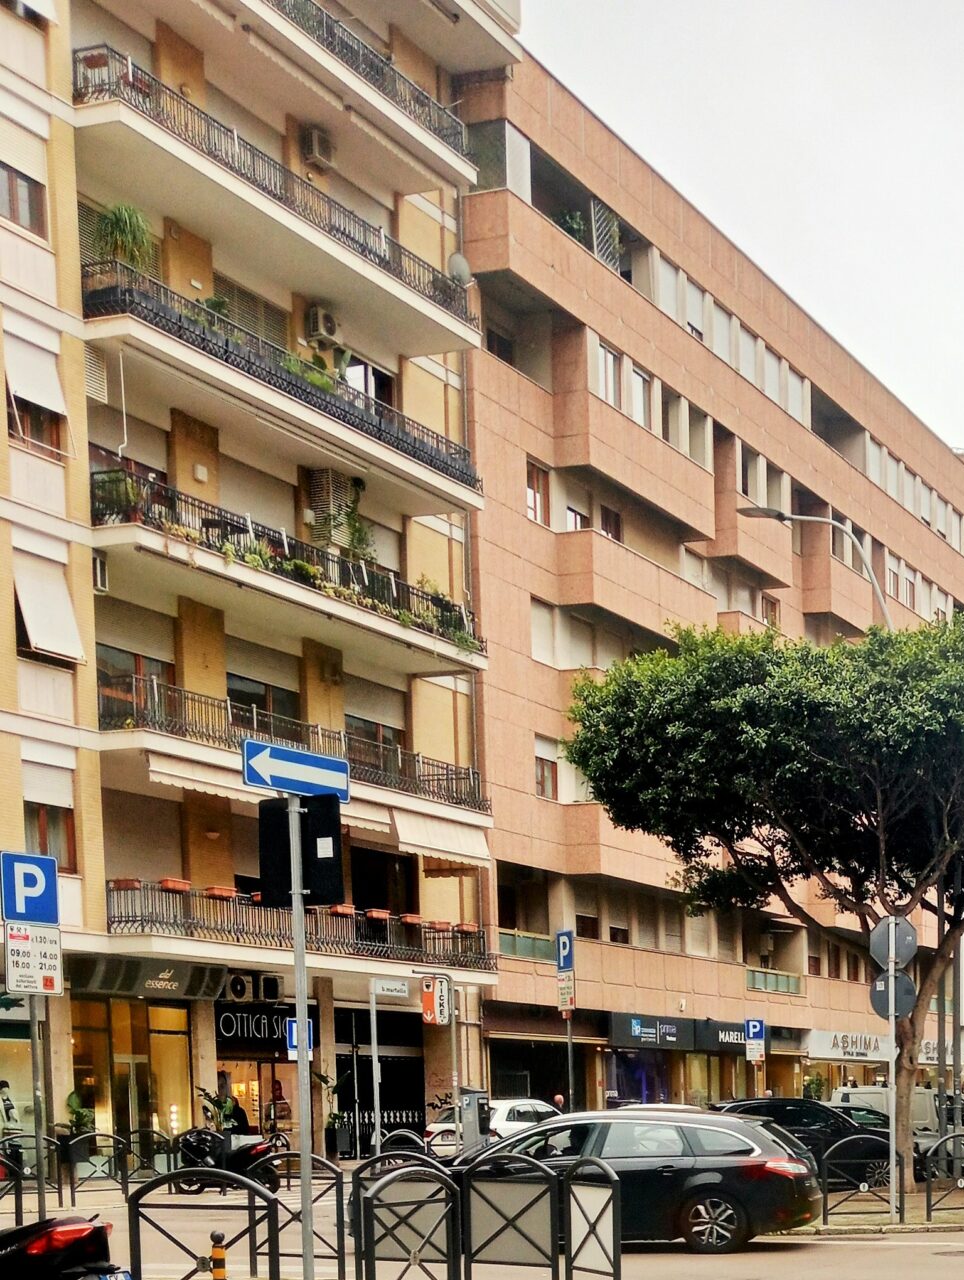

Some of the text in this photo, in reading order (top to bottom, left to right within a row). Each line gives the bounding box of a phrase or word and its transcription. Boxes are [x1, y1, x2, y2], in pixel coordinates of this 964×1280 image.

[13, 861, 46, 914] P
[559, 935, 570, 967] P
[144, 979, 179, 990] essence
[438, 980, 446, 1023] TICKE
[220, 1012, 268, 1039] OTTICA
[718, 1030, 746, 1044] MARELL
[748, 1020, 761, 1038] P
[831, 1033, 880, 1052] ASHIMA
